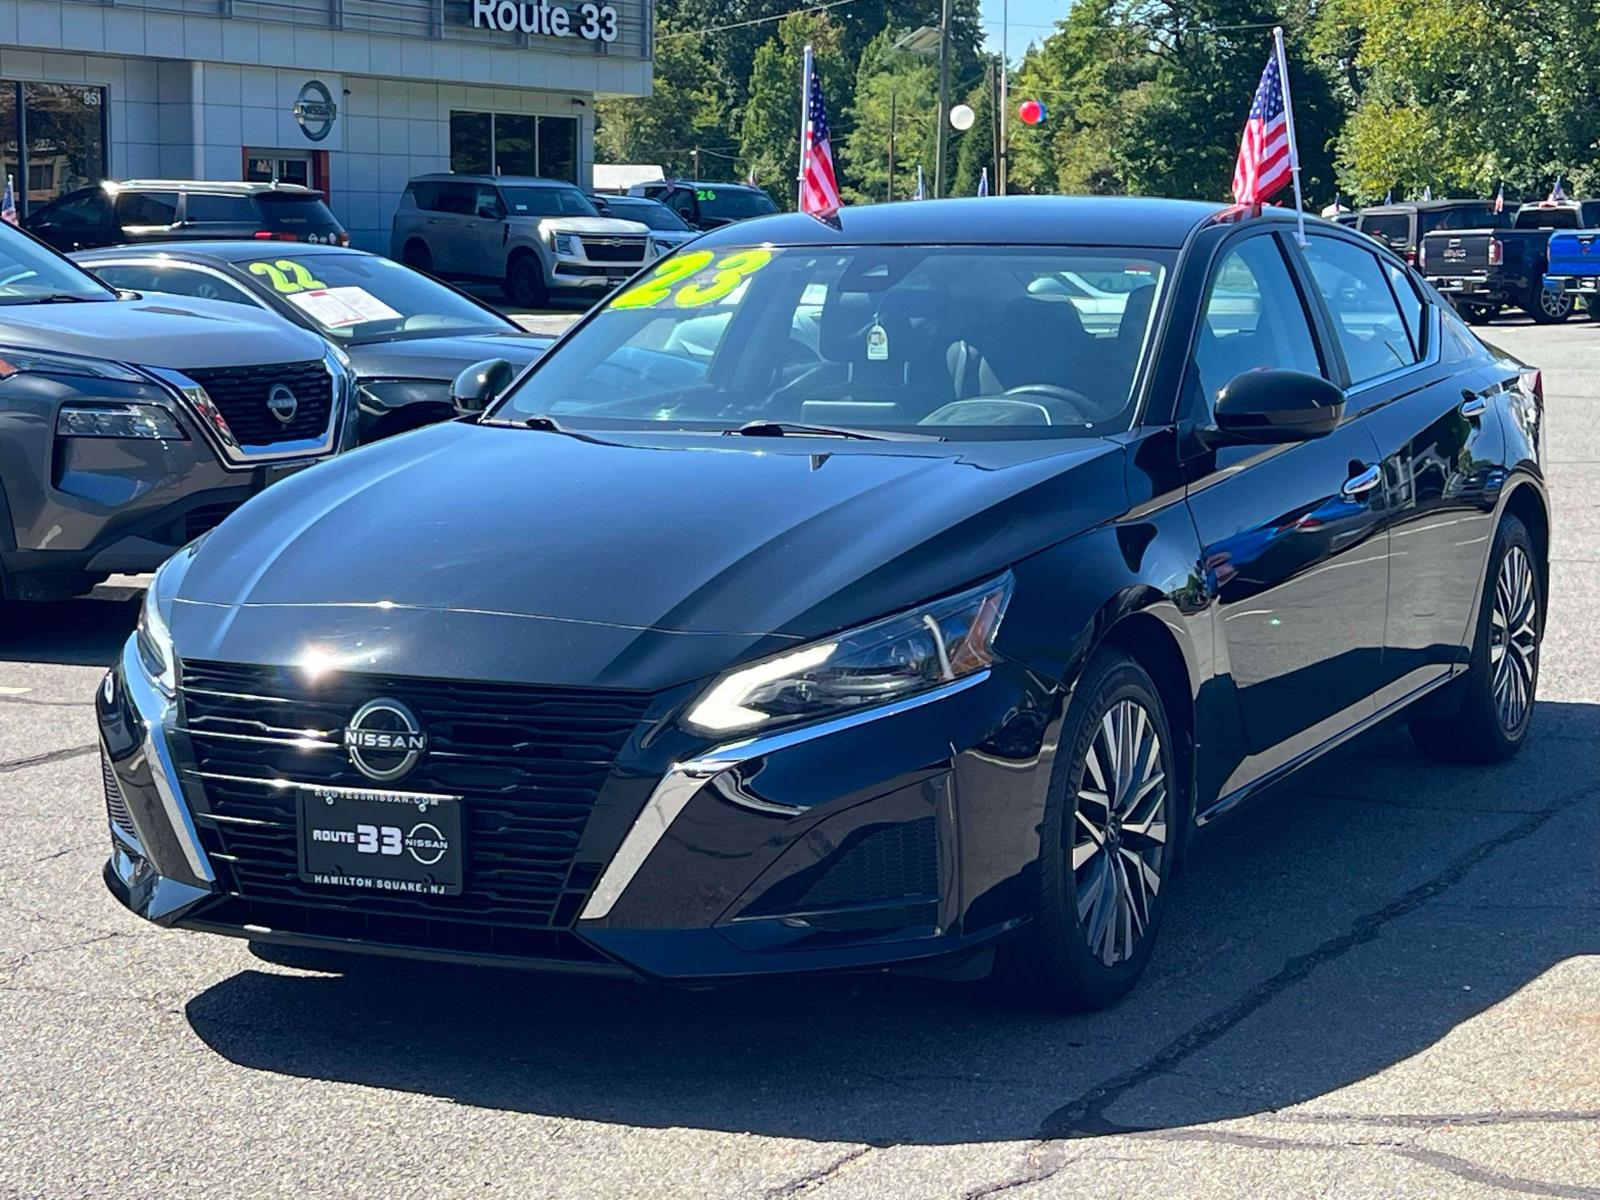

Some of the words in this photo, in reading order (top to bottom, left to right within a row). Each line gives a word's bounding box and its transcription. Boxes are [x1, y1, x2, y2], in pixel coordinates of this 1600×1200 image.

[474, 0, 570, 37] Route
[580, 3, 618, 42] 33
[83, 92, 101, 105] 951
[696, 191, 716, 201] 26
[248, 259, 328, 293] 22
[609, 250, 773, 309] 23
[344, 731, 424, 749] NISSAN
[313, 829, 355, 844] ROUTE
[357, 824, 403, 855] 33
[405, 838, 448, 849] NISSAN
[314, 874, 372, 887] HAMILTON
[376, 879, 427, 893] SQUARE,
[430, 885, 445, 894] NJ
